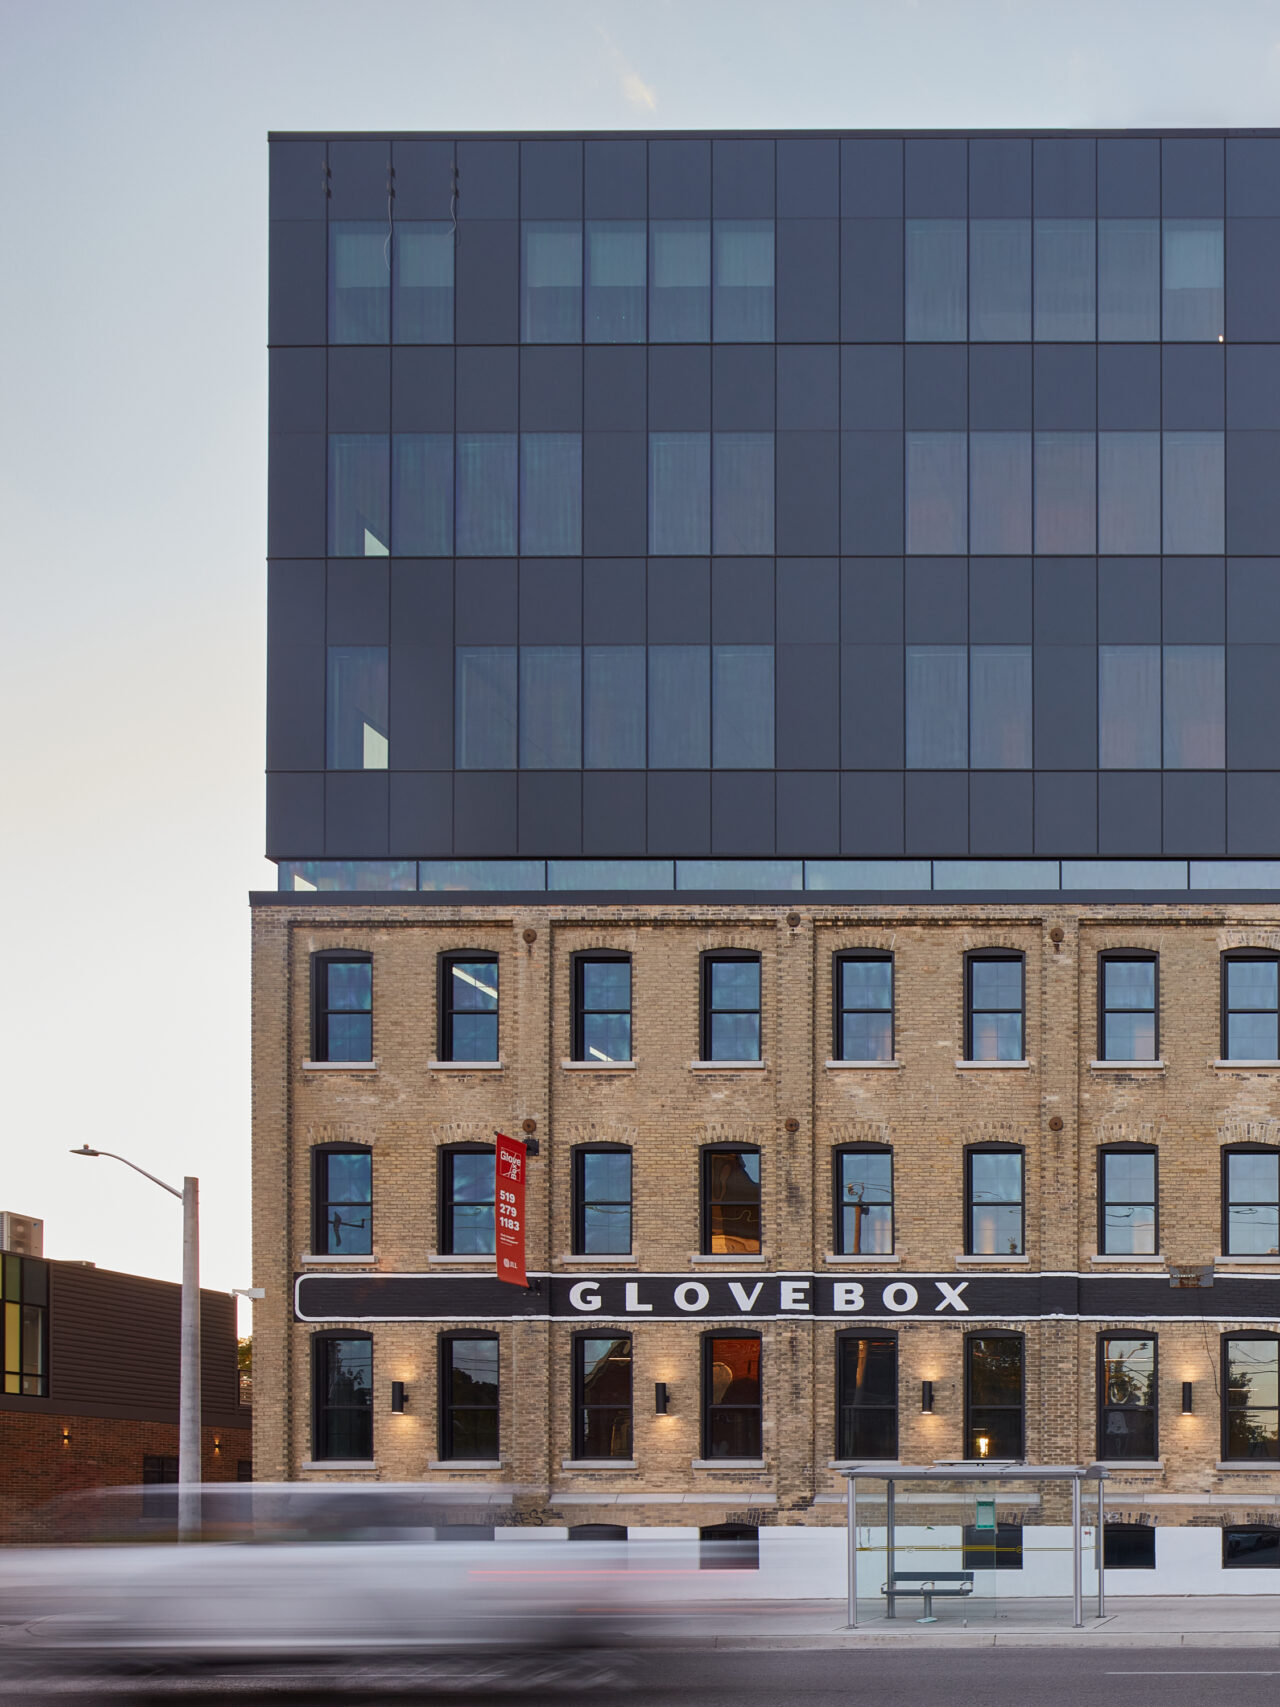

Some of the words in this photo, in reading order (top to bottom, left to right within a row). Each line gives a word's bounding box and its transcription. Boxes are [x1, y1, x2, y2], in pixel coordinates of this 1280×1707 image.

[500, 1150, 521, 1167] Glove
[500, 1190, 515, 1203] 519
[499, 1203, 517, 1217] 279
[499, 1217, 520, 1231] 1183
[569, 1281, 970, 1312] GLOVEBOX
